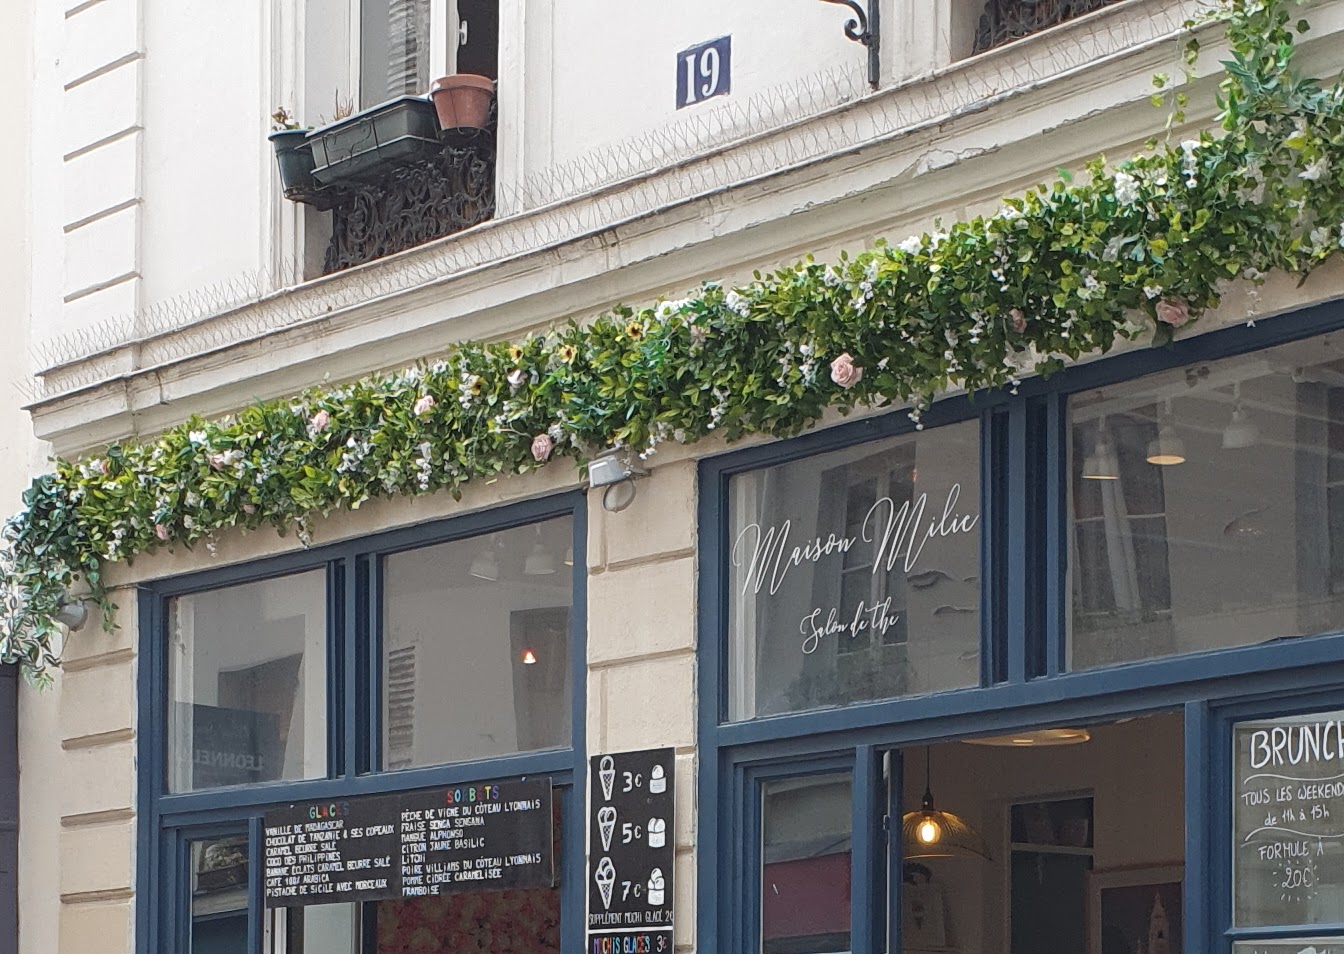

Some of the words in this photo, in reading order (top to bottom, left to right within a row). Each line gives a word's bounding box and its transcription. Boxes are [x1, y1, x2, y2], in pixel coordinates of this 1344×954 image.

[685, 47, 720, 104] 19
[732, 519, 857, 597] Maison
[800, 607, 849, 654] Salon
[849, 600, 869, 638] de
[447, 785, 500, 804] SORBETS
[1241, 788, 1270, 806] TOUS
[1276, 785, 1293, 802] LES
[309, 802, 350, 819] GLACES
[425, 809, 434, 819] DE
[462, 805, 472, 815] DU
[1264, 812, 1277, 826] de
[1282, 808, 1296, 823] 11h
[1299, 808, 1307, 821] à
[1310, 804, 1330, 820] 15h
[351, 828, 363, 837] SES
[401, 821, 426, 833] FRAISE
[454, 837, 485, 849] BASILIC
[1258, 841, 1309, 861] FORMULE
[463, 860, 472, 870] DU
[1282, 867, 1313, 889] 20€
[300, 885, 309, 894] DE
